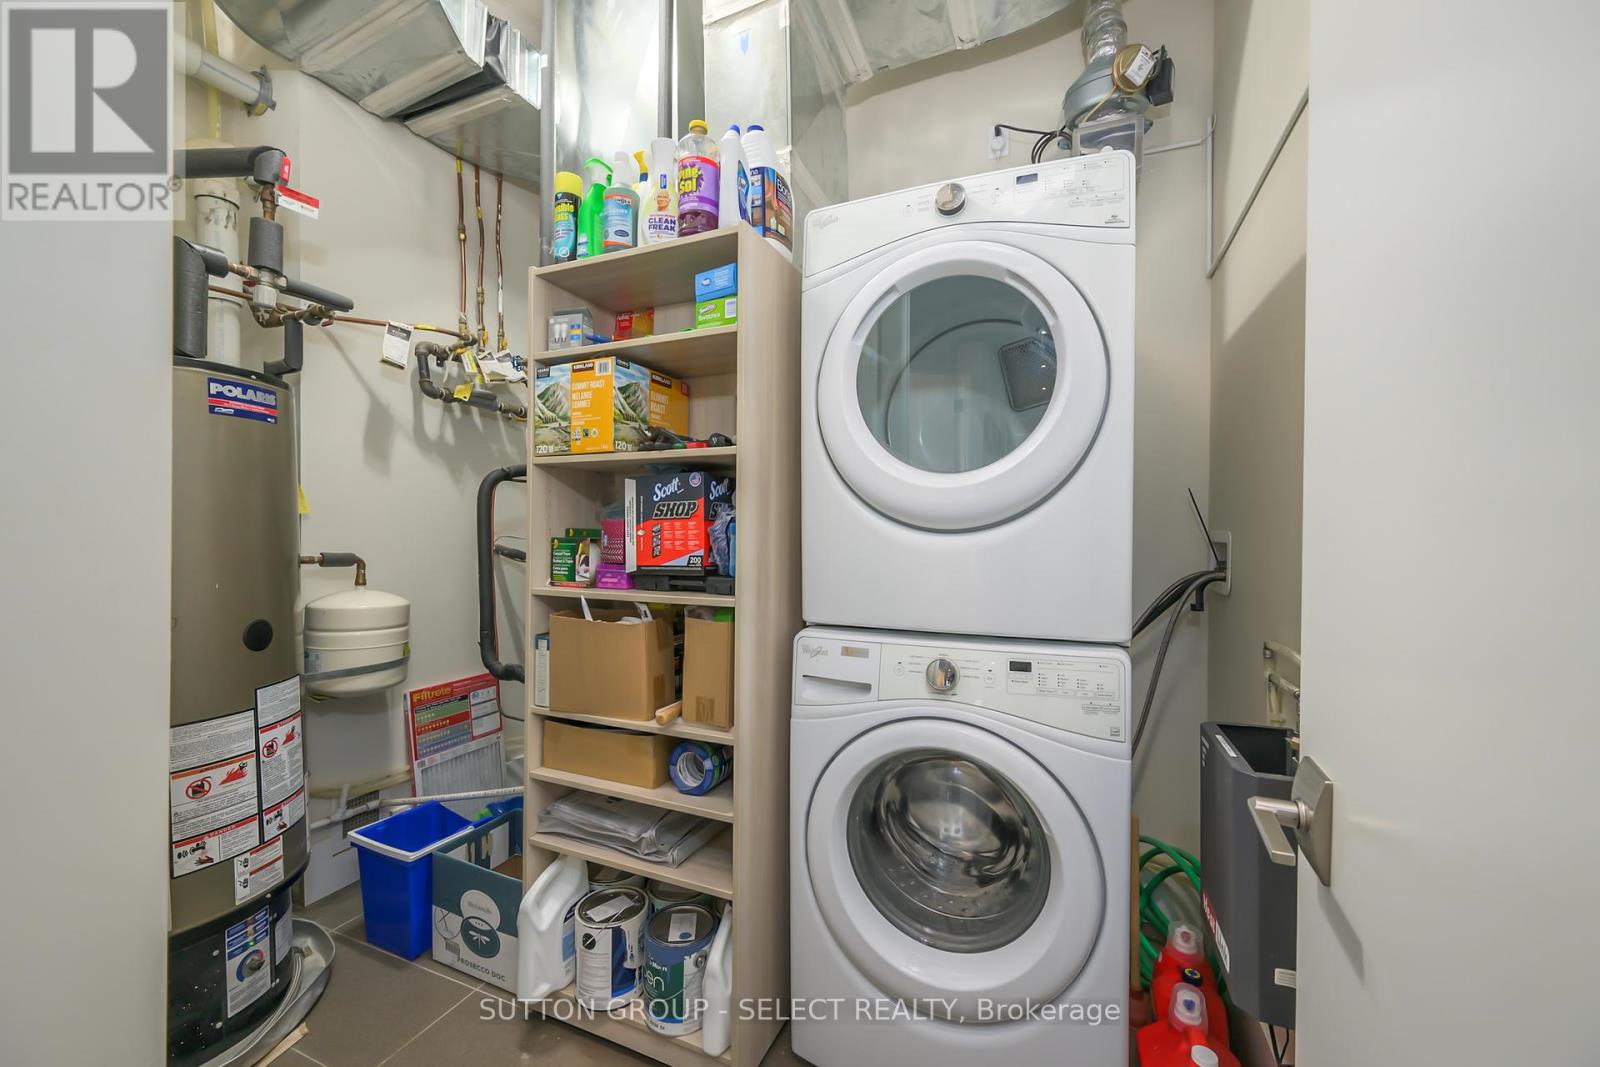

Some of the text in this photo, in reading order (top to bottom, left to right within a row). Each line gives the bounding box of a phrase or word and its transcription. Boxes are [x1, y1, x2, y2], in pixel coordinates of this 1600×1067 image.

[648, 217, 676, 225] CLEAN
[648, 224, 676, 232] FREAK
[209, 382, 276, 406] POLARIS
[653, 476, 680, 501] Scott
[652, 501, 698, 519] SHOP
